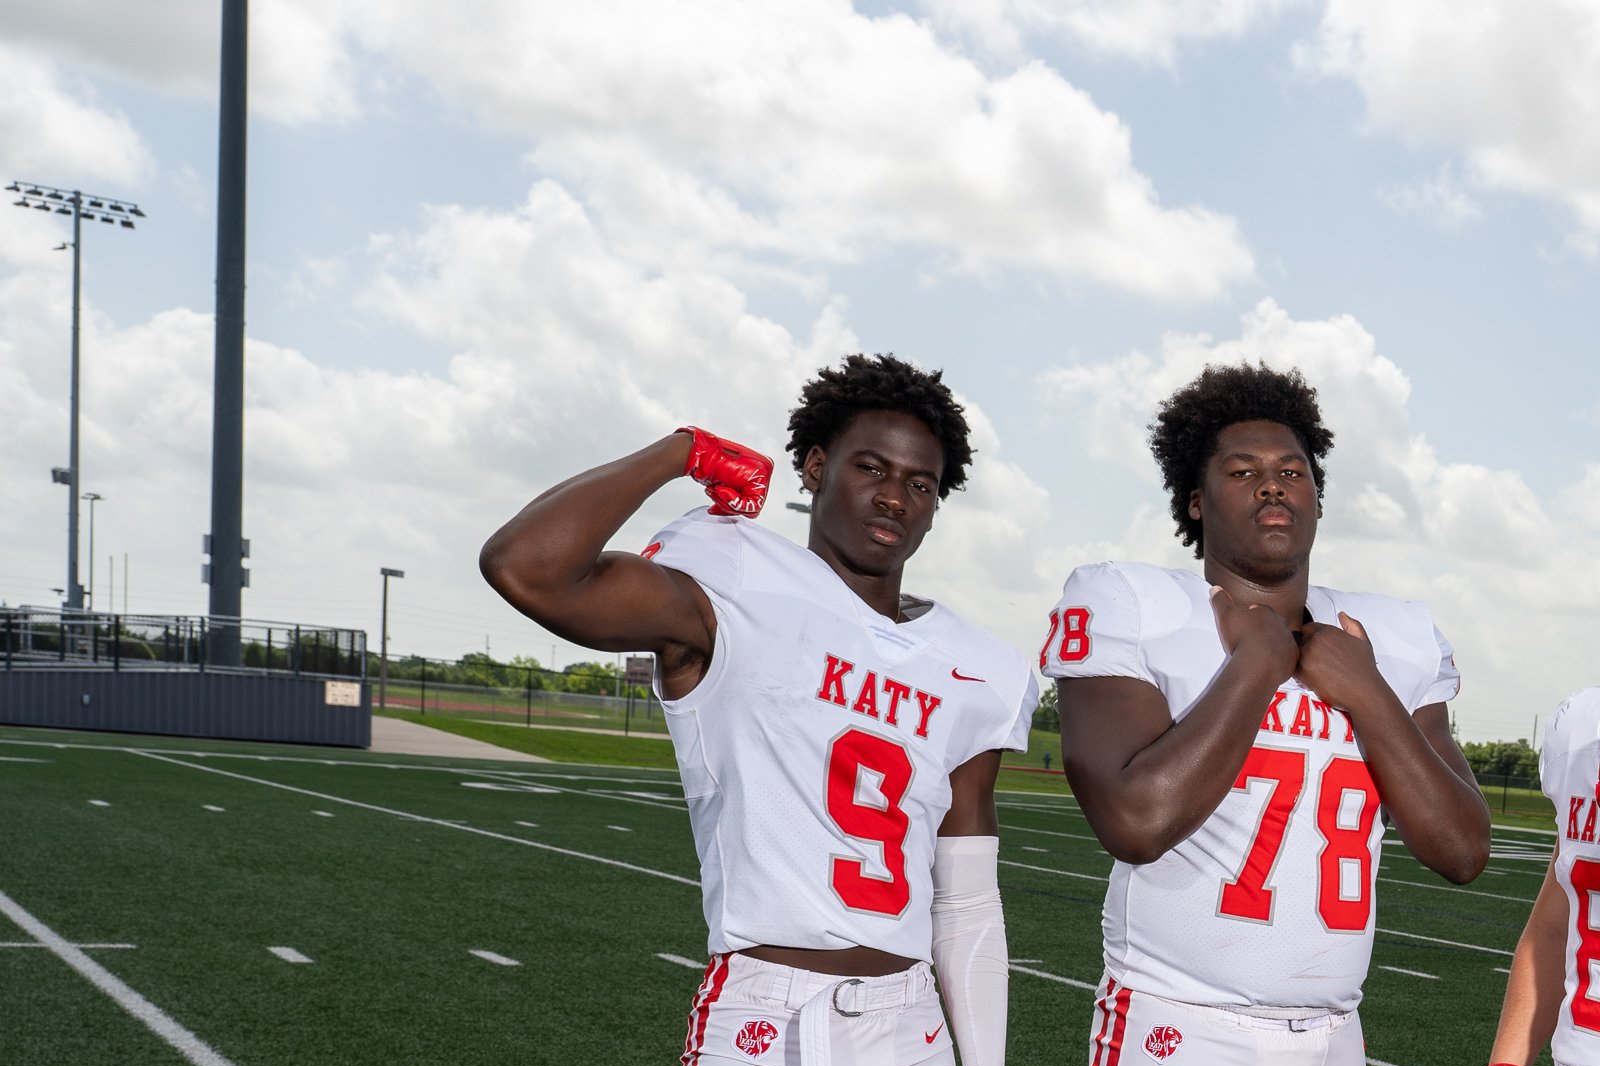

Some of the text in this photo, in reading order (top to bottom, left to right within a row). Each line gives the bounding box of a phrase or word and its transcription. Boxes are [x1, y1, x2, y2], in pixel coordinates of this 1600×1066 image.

[816, 651, 942, 741] KATY
[823, 723, 917, 922] 9
[1214, 743, 1382, 936] 78
